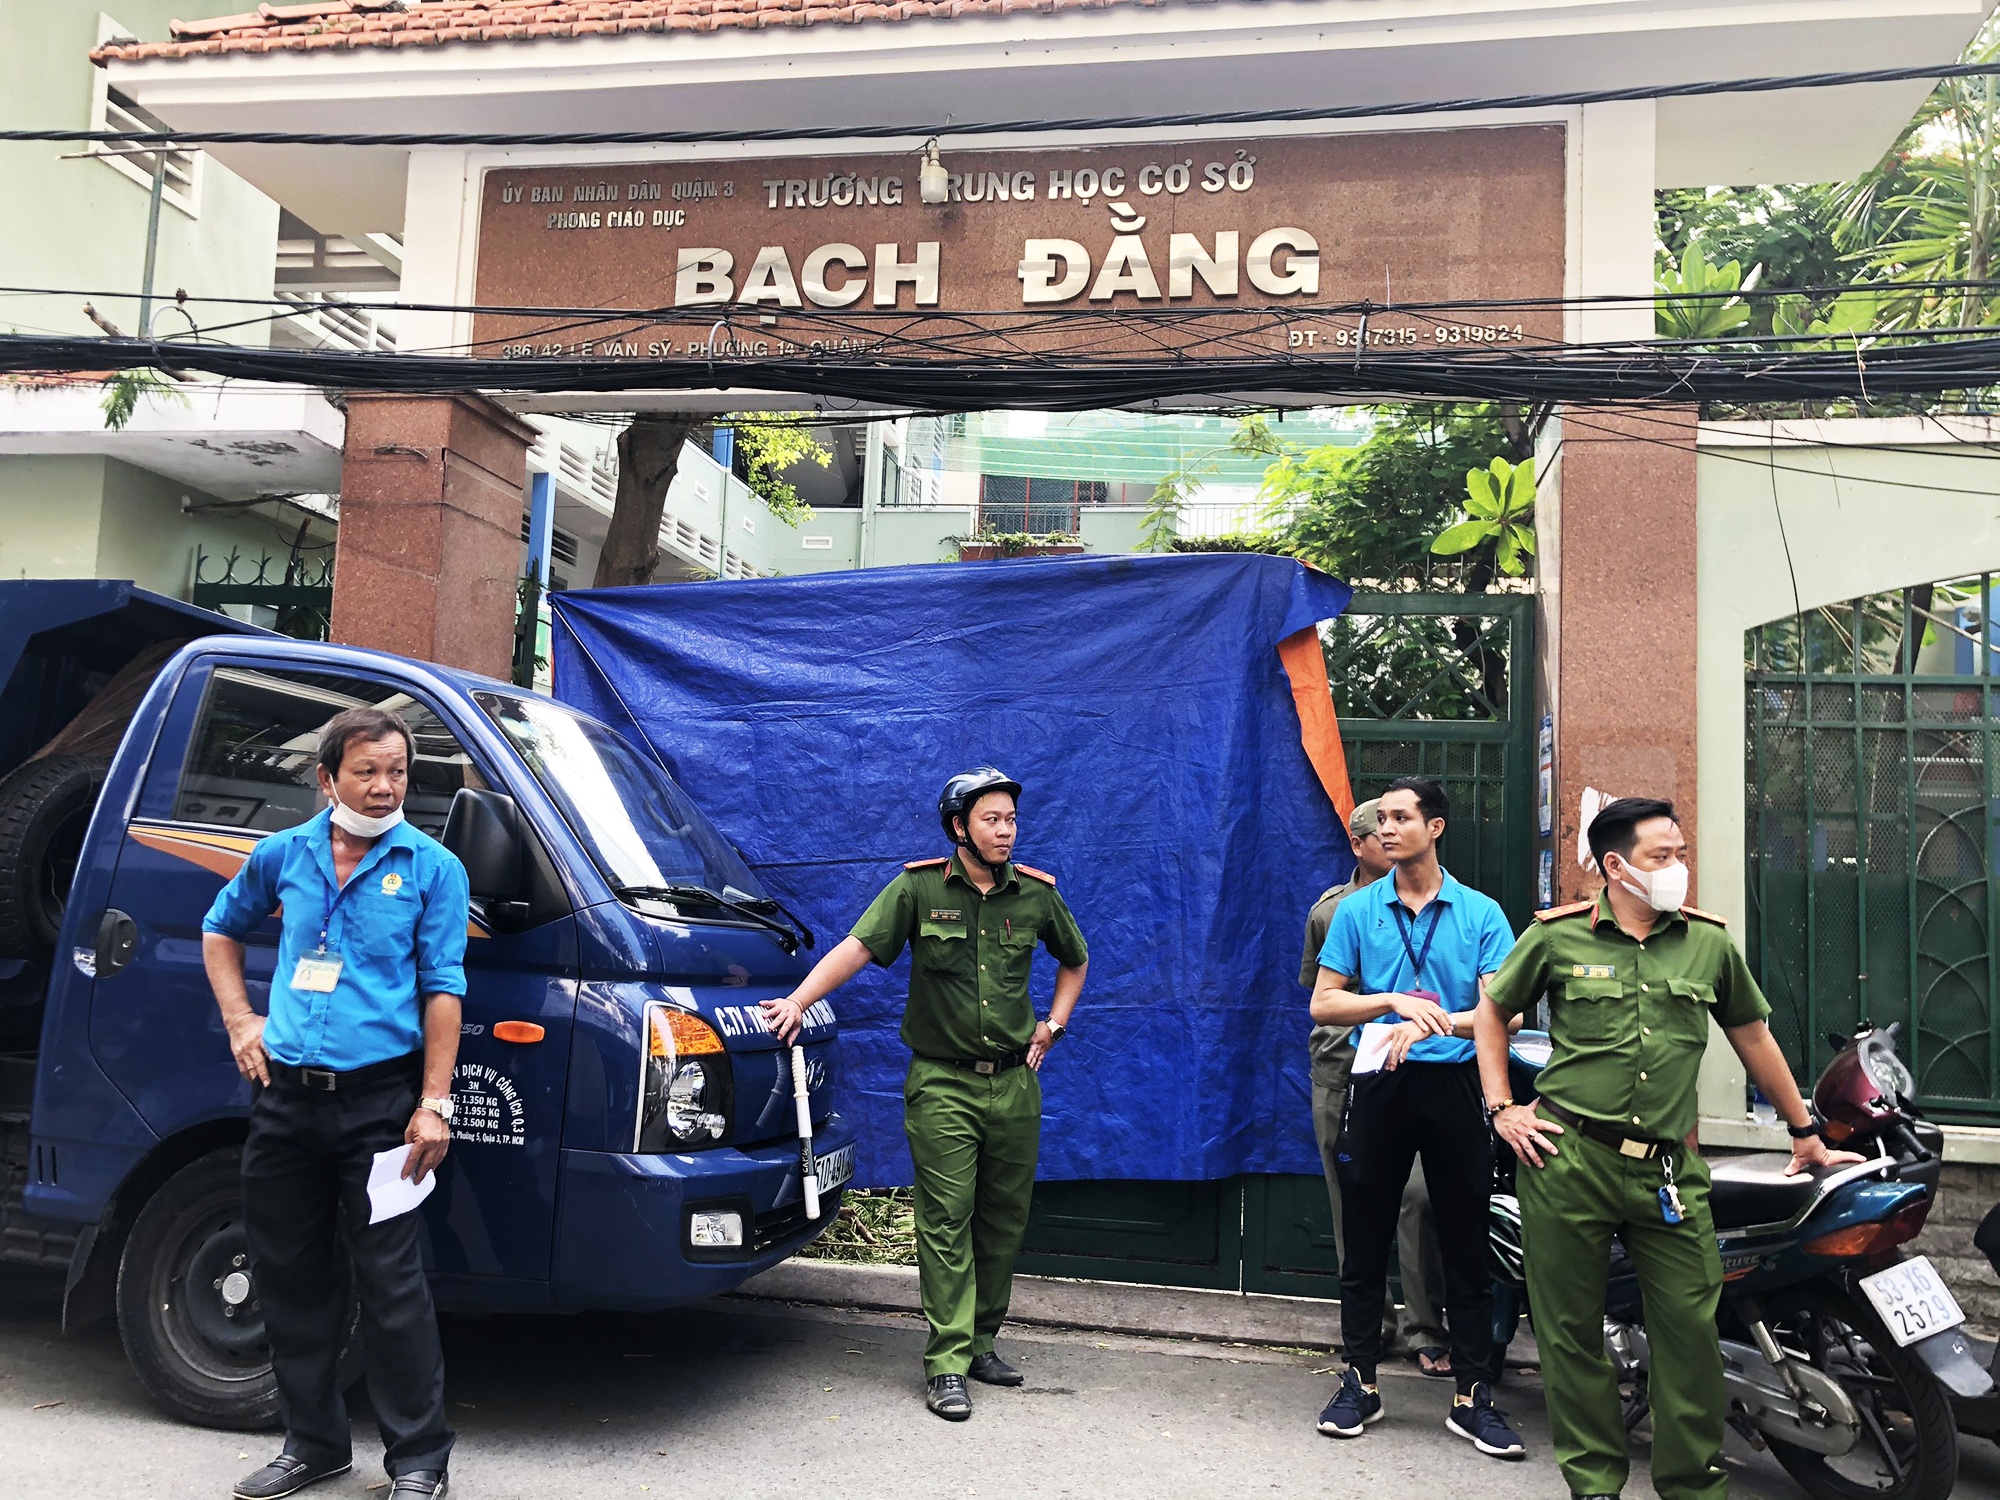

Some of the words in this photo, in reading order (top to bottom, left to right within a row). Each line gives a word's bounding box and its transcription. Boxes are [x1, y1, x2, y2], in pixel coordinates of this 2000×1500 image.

[917, 170, 1036, 204] RUNG
[1048, 166, 1126, 207] HỌC
[1138, 159, 1193, 196] CƠ
[1200, 148, 1257, 193] SỞ
[502, 181, 524, 204] ỦY
[530, 186, 564, 203] BAN
[573, 180, 619, 202] NHÂN
[627, 179, 662, 200] DÂN
[671, 176, 716, 202] QUẬN
[723, 180, 735, 197] 3
[547, 207, 601, 229] PHÒNG
[606, 206, 645, 228] GIÁO
[652, 209, 686, 232] DỤC
[674, 241, 940, 324] BẠCH
[1018, 202, 1320, 305] ĐẰNG
[1434, 324, 1524, 344] 9319824
[777, 342, 796, 357] 14
[462, 1063, 484, 1079] DỊCH
[484, 1067, 498, 1084] VỤ
[495, 1076, 517, 1101] CÔNG
[508, 1098, 524, 1117] ÍCH
[468, 1081, 479, 1091] 3N
[462, 1094, 485, 1106] 1.350
[486, 1096, 498, 1107] KG
[464, 1105, 487, 1117] 1.955
[488, 1107, 500, 1118] KG
[462, 1117, 486, 1128] 3.500
[487, 1119, 499, 1130] KG
[1893, 1294, 1951, 1337] 2529
